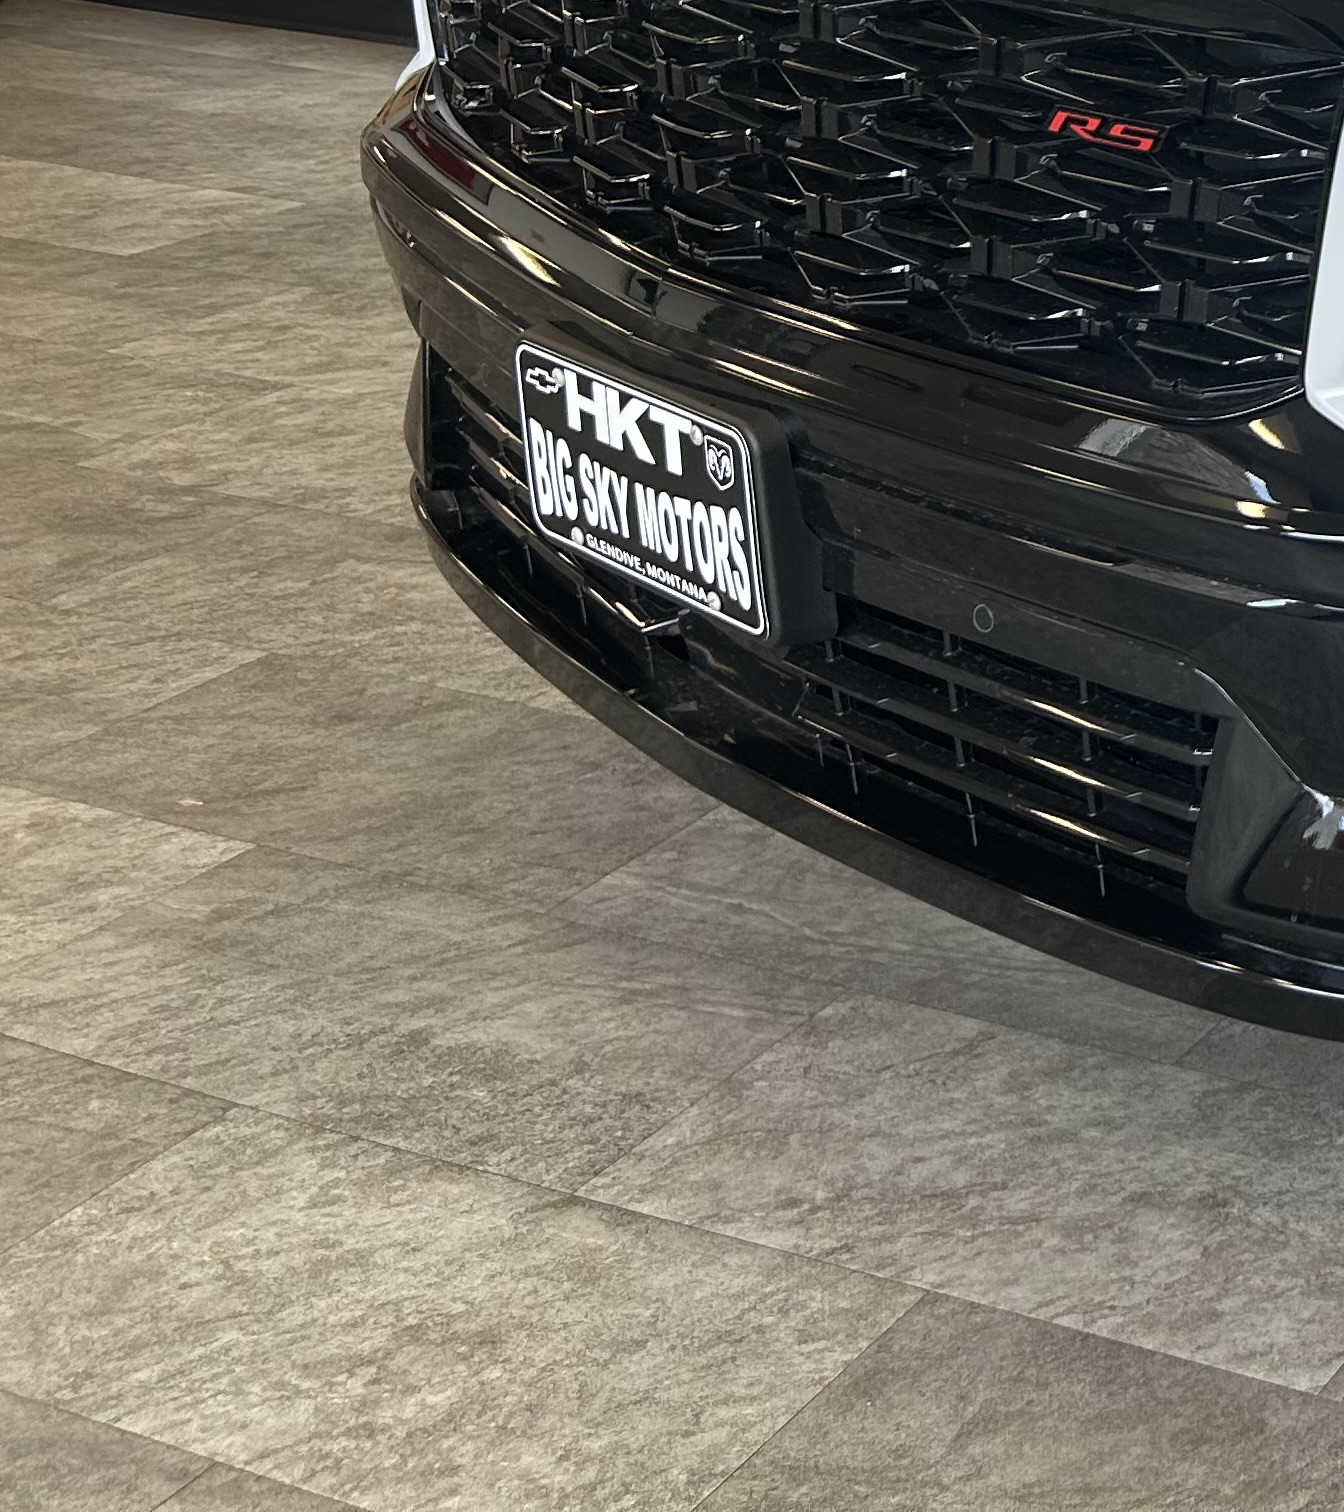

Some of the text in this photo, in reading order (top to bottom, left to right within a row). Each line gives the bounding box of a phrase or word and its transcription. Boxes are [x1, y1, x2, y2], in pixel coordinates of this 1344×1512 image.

[1047, 110, 1160, 152] RS
[563, 368, 693, 477] HKT
[529, 416, 751, 612] BIG SKY MOTORS
[585, 533, 709, 604] GLENDIVE, MONTANA
